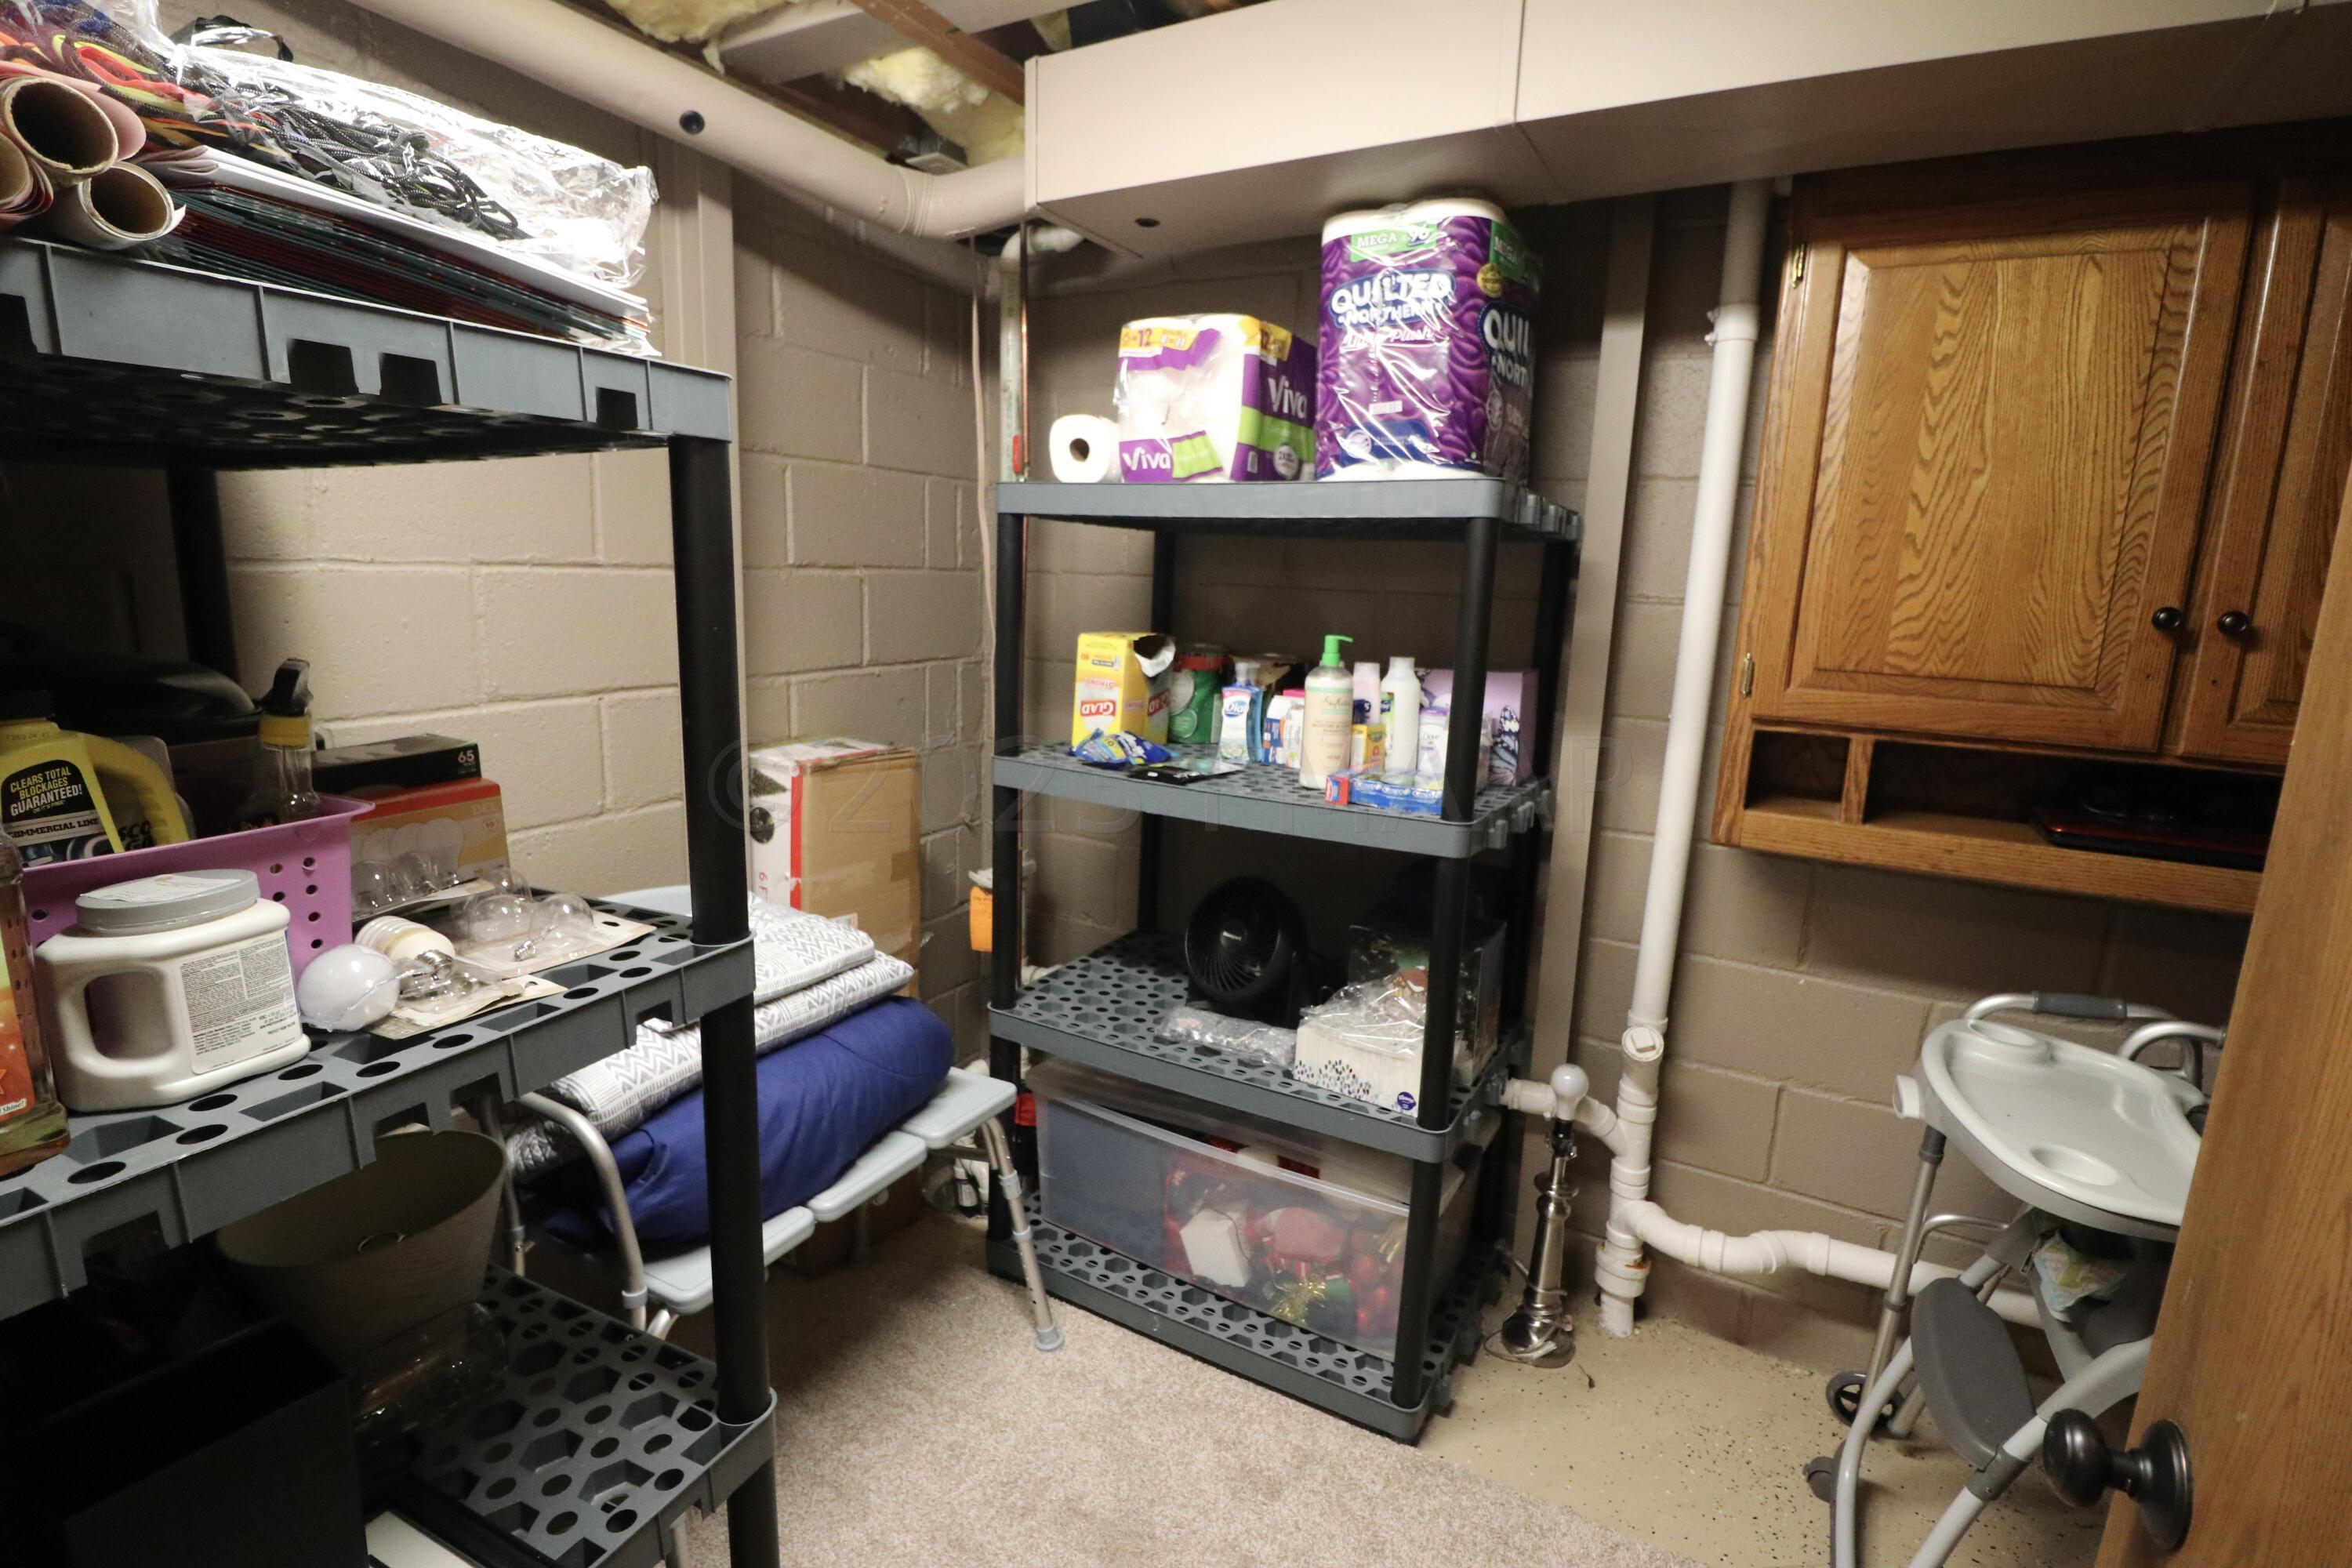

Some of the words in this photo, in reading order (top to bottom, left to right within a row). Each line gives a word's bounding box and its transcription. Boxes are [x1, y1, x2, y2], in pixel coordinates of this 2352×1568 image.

[1357, 233, 1397, 249] MEGA
[1331, 272, 1453, 314] QUILTED
[1269, 376, 1307, 419] Viva
[1123, 447, 1172, 470] Viva
[1081, 701, 1115, 714] GLAD
[458, 750, 475, 764] 65
[10, 773, 43, 793] CLEARS
[45, 766, 71, 781] TOTAL
[20, 777, 68, 800] BLOCKAGES
[10, 784, 83, 816] GUARANTEED!
[7, 822, 76, 839] COMMERCIAL
[78, 818, 100, 828] LINE
